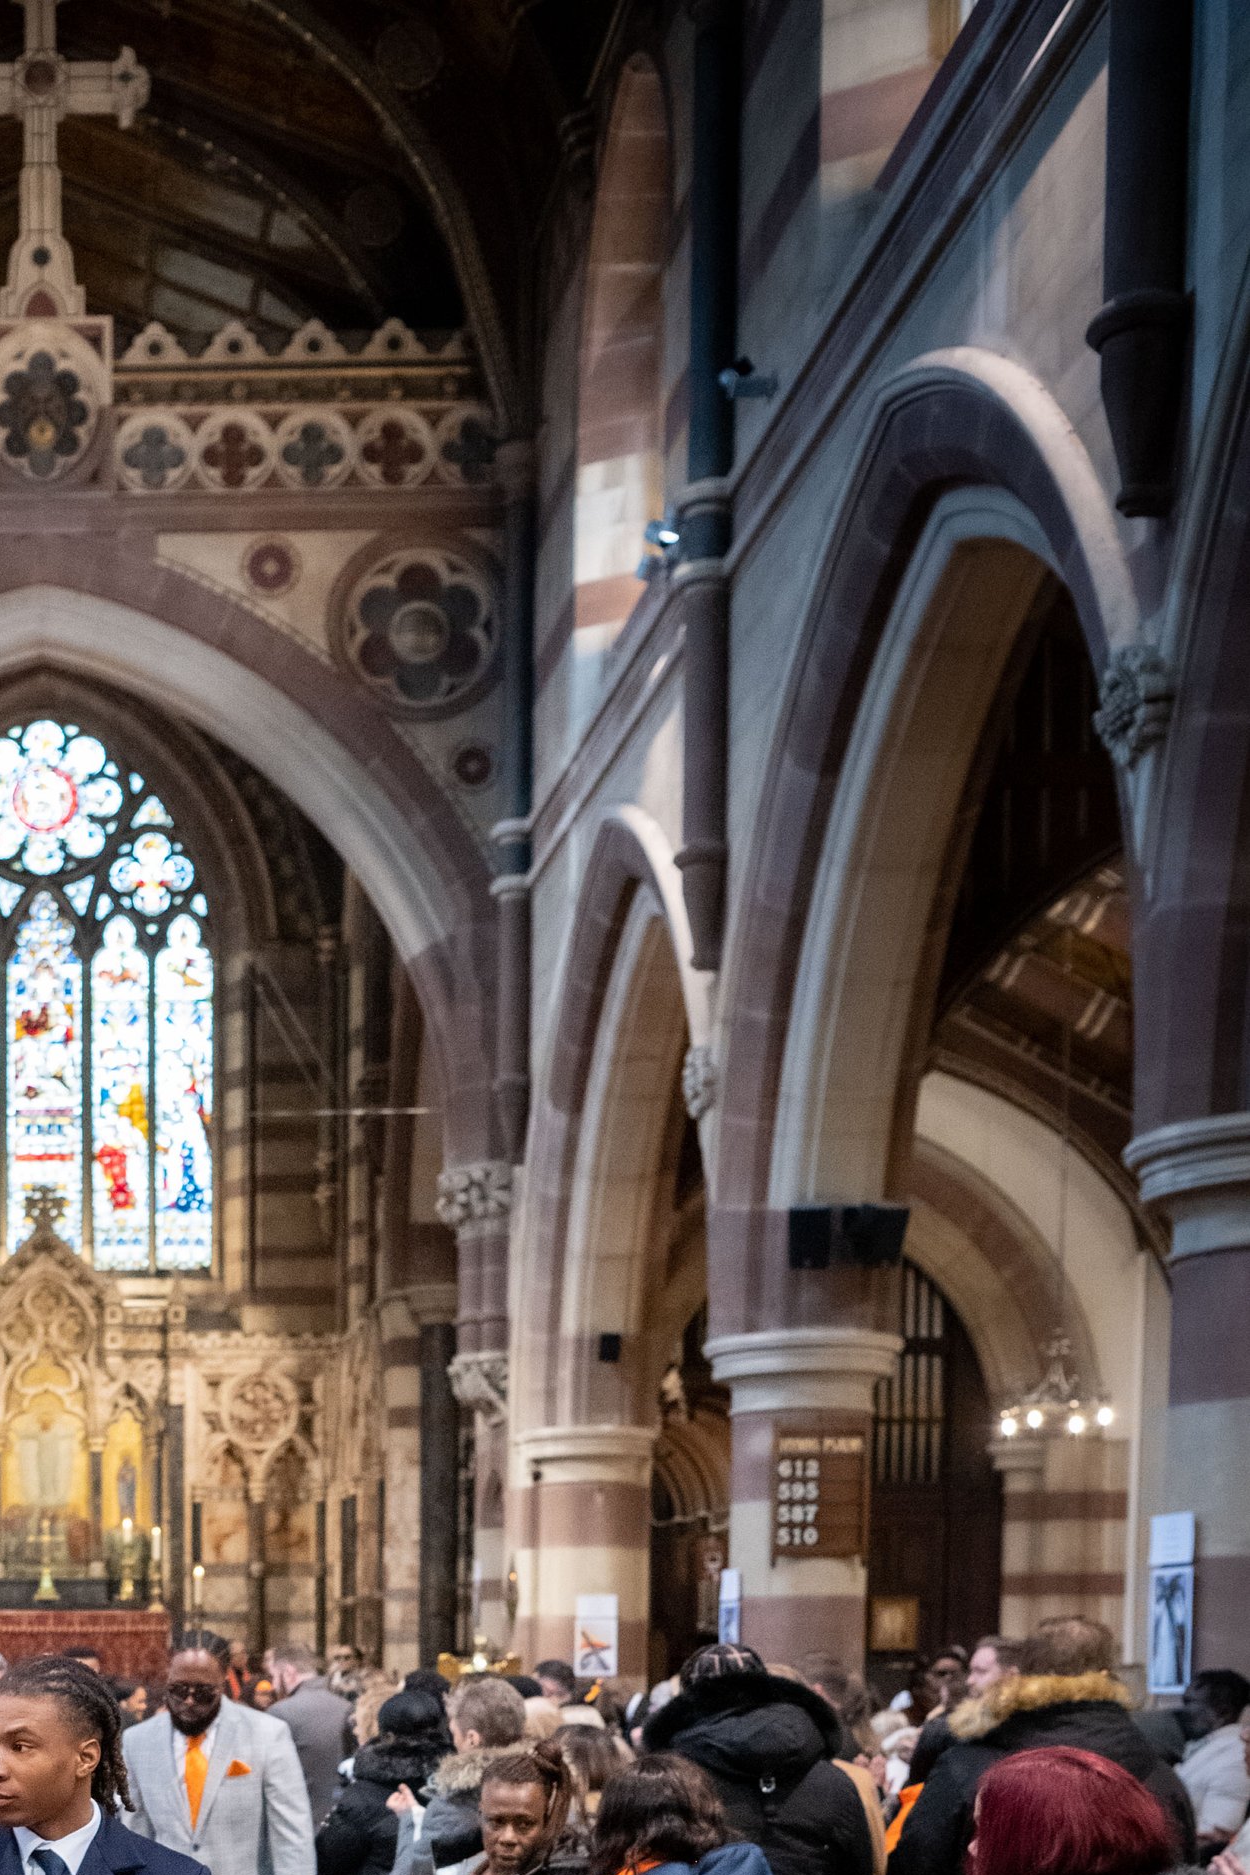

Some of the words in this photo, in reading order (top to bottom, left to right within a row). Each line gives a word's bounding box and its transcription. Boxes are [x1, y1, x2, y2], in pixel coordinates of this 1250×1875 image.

[777, 1459, 819, 1478] 612
[778, 1481, 819, 1501] 595
[777, 1504, 818, 1524] 587
[776, 1526, 819, 1546] 510
